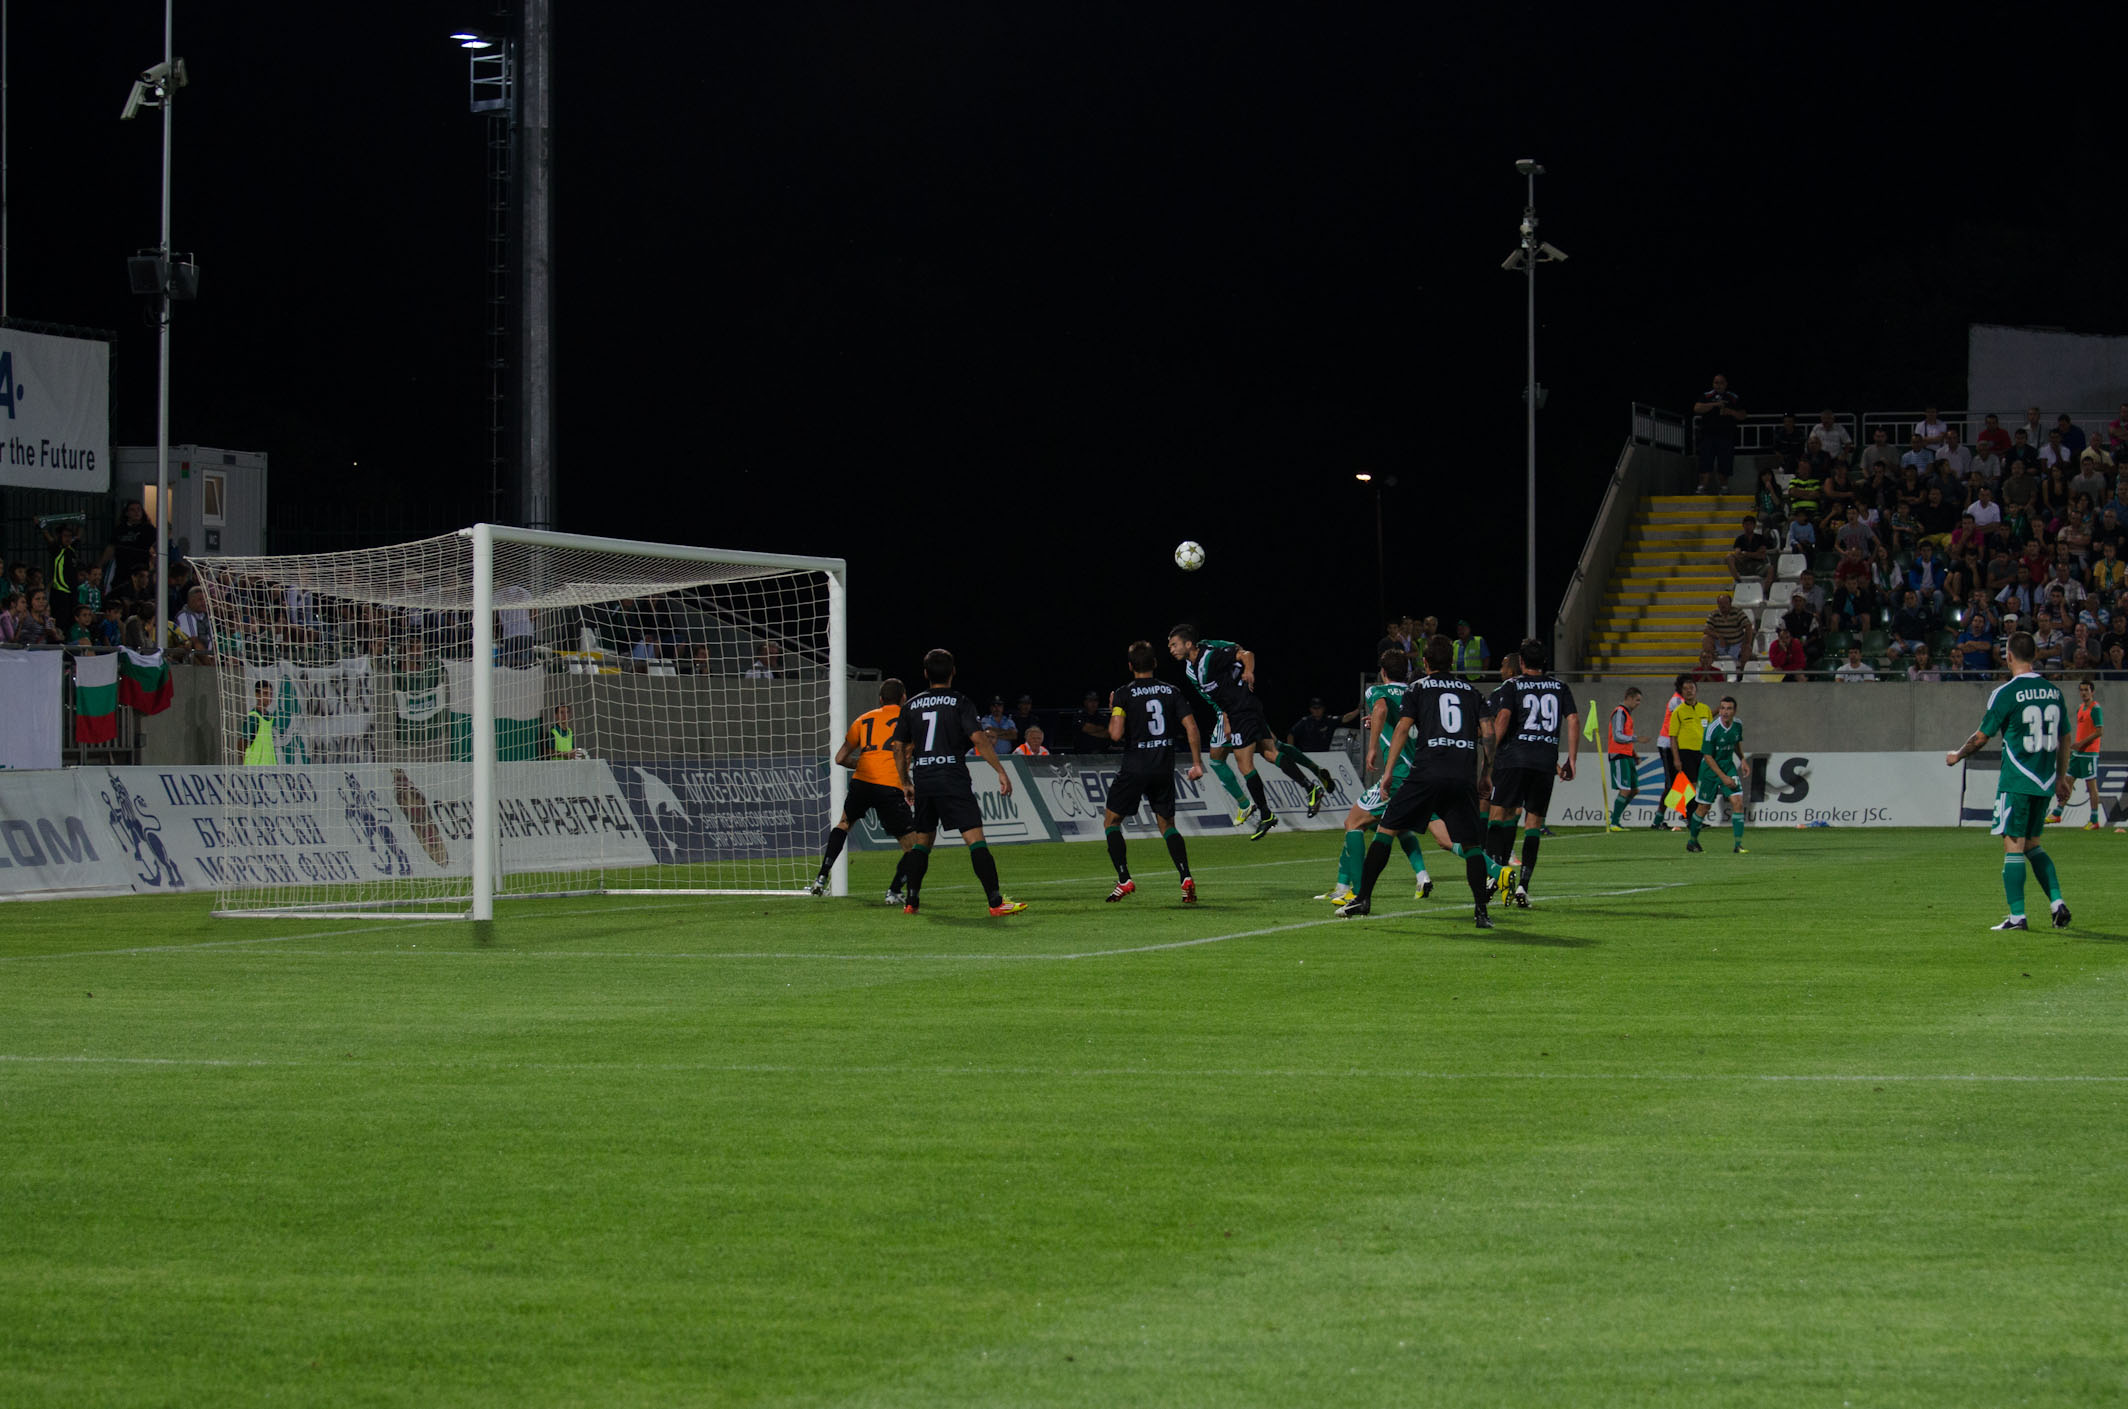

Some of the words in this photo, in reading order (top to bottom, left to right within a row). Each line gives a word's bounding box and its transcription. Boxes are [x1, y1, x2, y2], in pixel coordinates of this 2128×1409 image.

[10, 437, 35, 466] the
[41, 439, 95, 471] Future
[1422, 678, 1472, 692] ИВАНОВ
[1516, 680, 1561, 691] МАРТИНС
[910, 695, 957, 711] АНДОНОВ
[1146, 698, 1166, 736] 3
[1438, 693, 1463, 734] 6
[1522, 693, 1560, 733] 29
[862, 717, 900, 752] 12
[922, 711, 939, 752] 7
[1427, 738, 1475, 750] БЕРОЕ
[2022, 703, 2061, 754] 33
[159, 772, 318, 808] ПАРАХОДСТВО
[682, 769, 792, 804] MTG-DOLPHIN
[789, 767, 824, 799] PLC
[193, 815, 327, 848] БЪЛГАРСКИ
[531, 794, 638, 839] РАЗГРАД
[1804, 807, 1860, 821] Broker
[1863, 807, 1892, 823] JSC.
